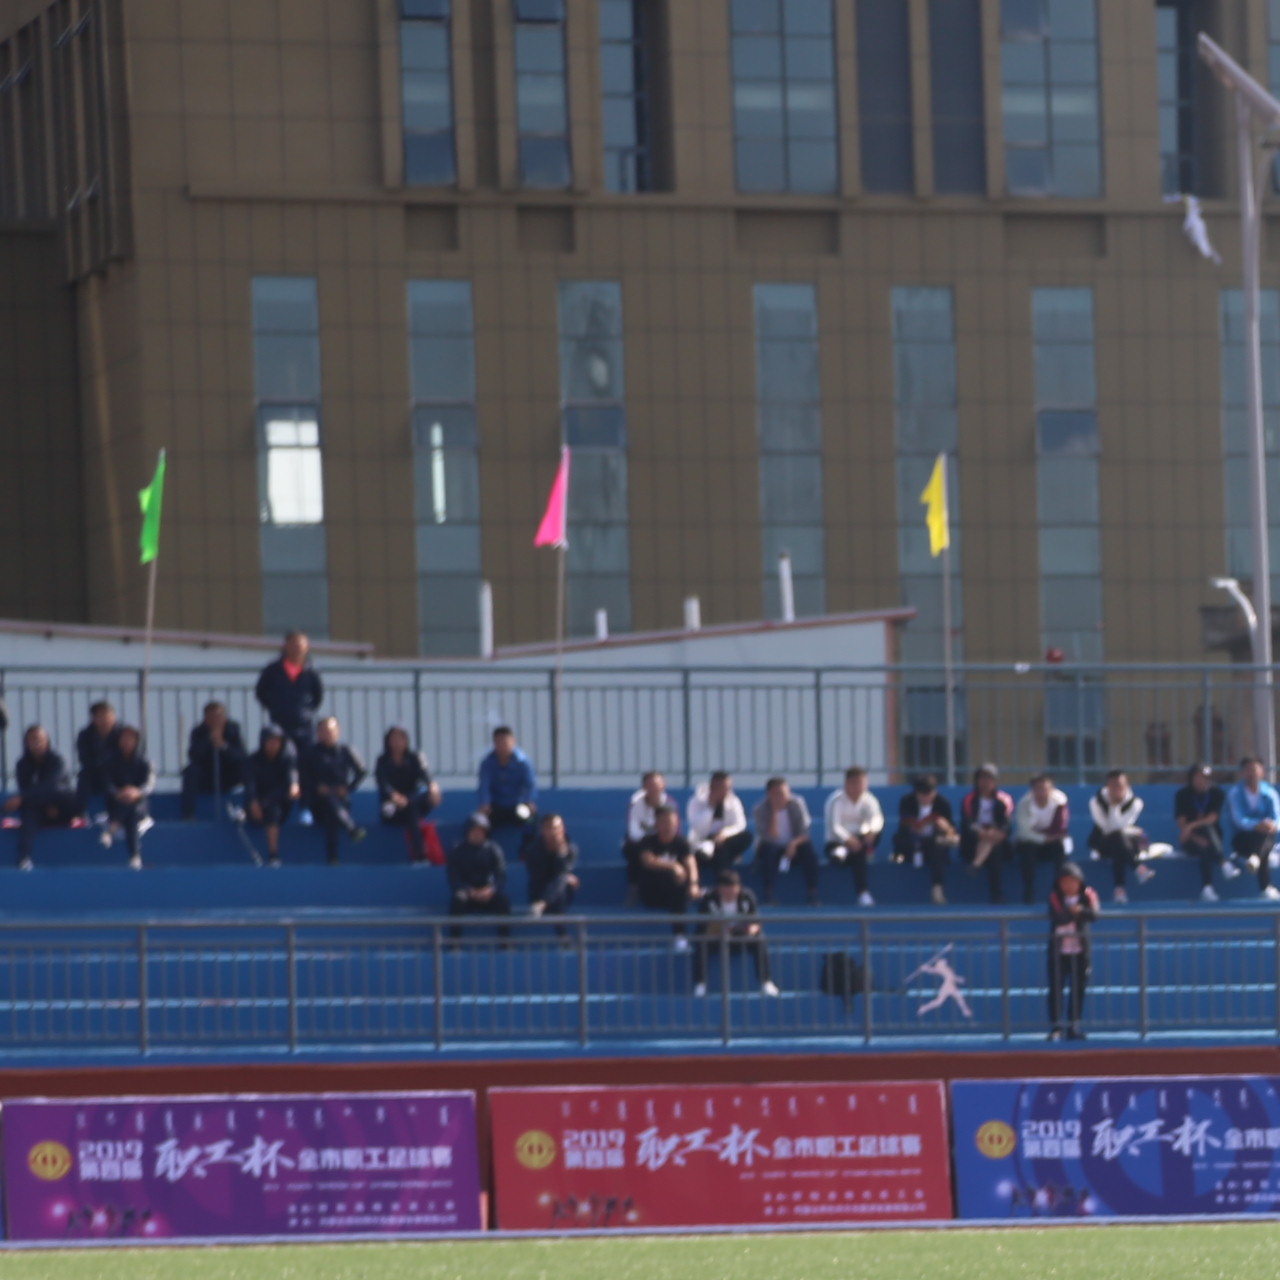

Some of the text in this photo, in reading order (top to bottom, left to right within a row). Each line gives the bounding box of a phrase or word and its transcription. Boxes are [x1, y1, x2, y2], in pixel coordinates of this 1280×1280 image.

[563, 1130, 625, 1149] 2019
[1021, 1120, 1081, 1139] 2019
[1090, 1116, 1222, 1161] 职工杯
[79, 1140, 143, 1160] 2019
[154, 1135, 294, 1182] 职工杯
[636, 1124, 770, 1171] 职工杯
